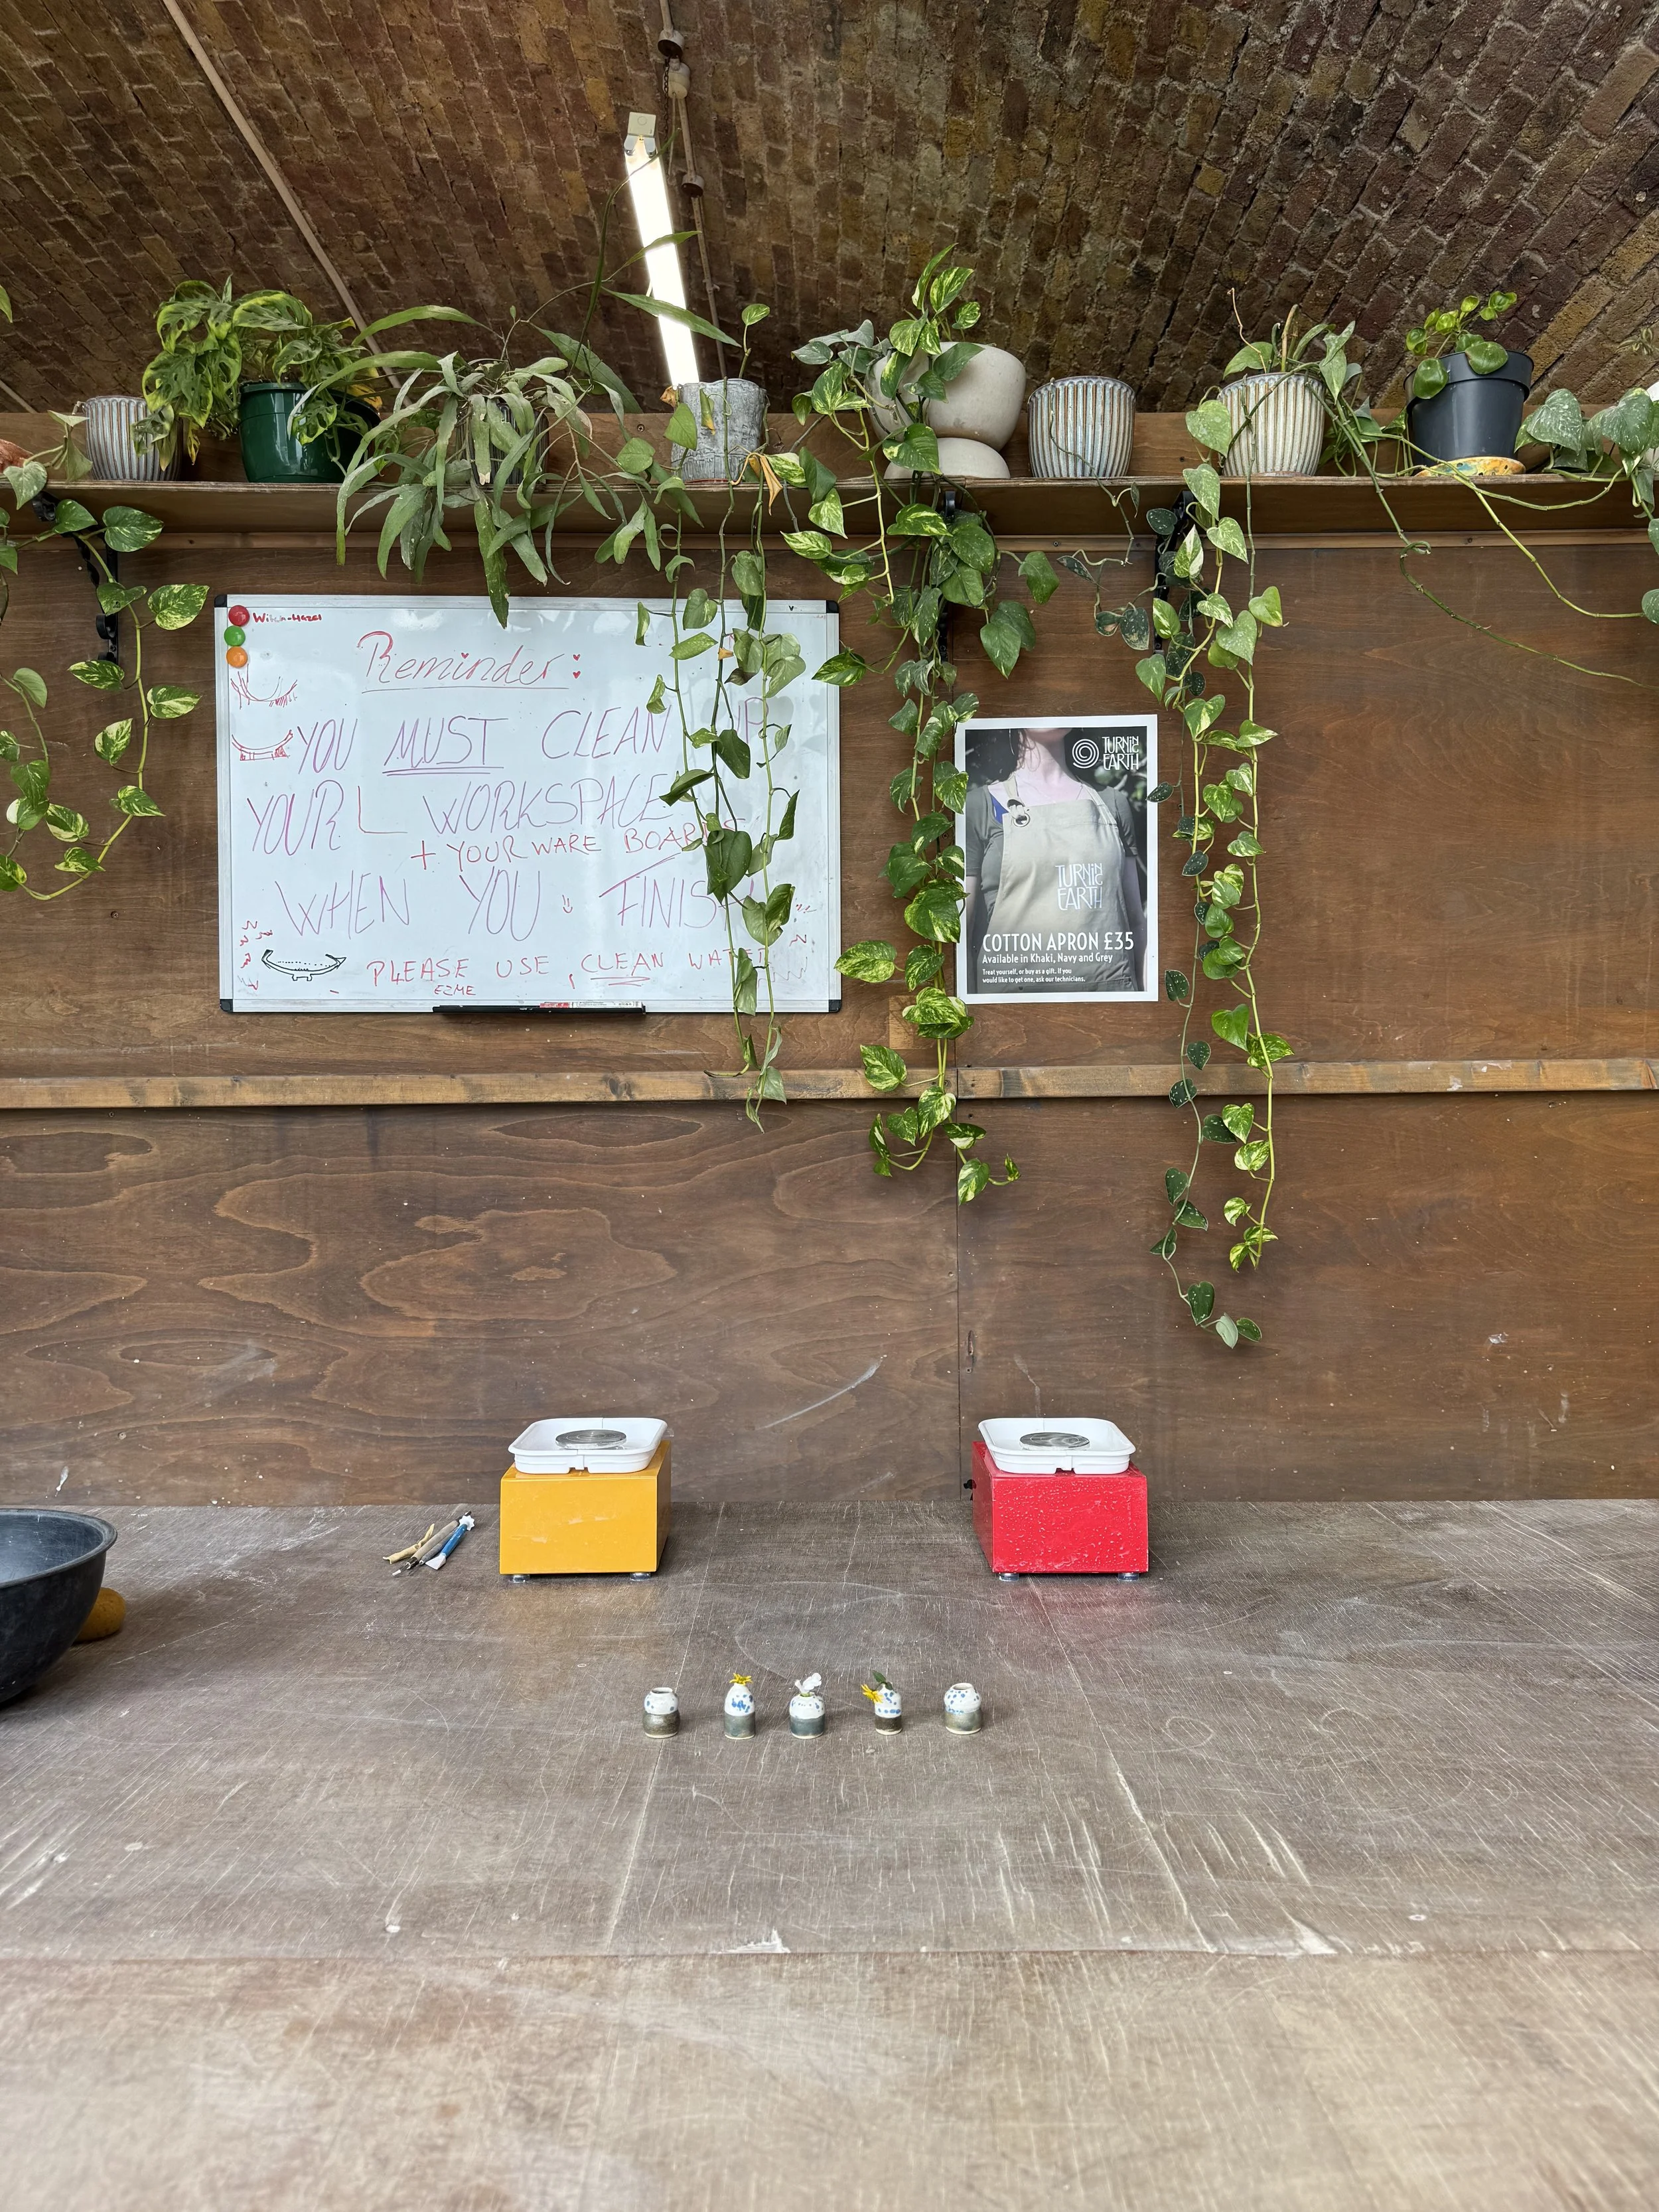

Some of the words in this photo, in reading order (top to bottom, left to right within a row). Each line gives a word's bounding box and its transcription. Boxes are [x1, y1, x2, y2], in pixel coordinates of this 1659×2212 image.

[297, 718, 358, 774] YOU
[383, 715, 509, 769] MUST
[541, 704, 672, 759] CLEAN
[1103, 753, 1139, 771] EARTH
[247, 780, 344, 855] YOUR
[423, 774, 674, 835] WORKSPACE
[447, 835, 528, 872] YOUR
[532, 834, 602, 855] WARE
[275, 869, 409, 940] WHEN
[460, 866, 540, 941] YOU
[1057, 886, 1102, 911] EARTH
[982, 932, 1043, 952] COTTON
[1046, 932, 1099, 951] APRON
[1104, 931, 1134, 951] £35
[982, 954, 1019, 964] Available
[1020, 954, 1029, 963] in
[1030, 953, 1056, 964] Khaki,
[1058, 952, 1076, 964] Navy
[1078, 952, 1094, 962] and
[1095, 952, 1113, 963] Grey
[366, 958, 470, 987] PLEASE
[496, 956, 549, 978] USE
[581, 952, 665, 976] CLEAN
[688, 948, 772, 970] WAT
